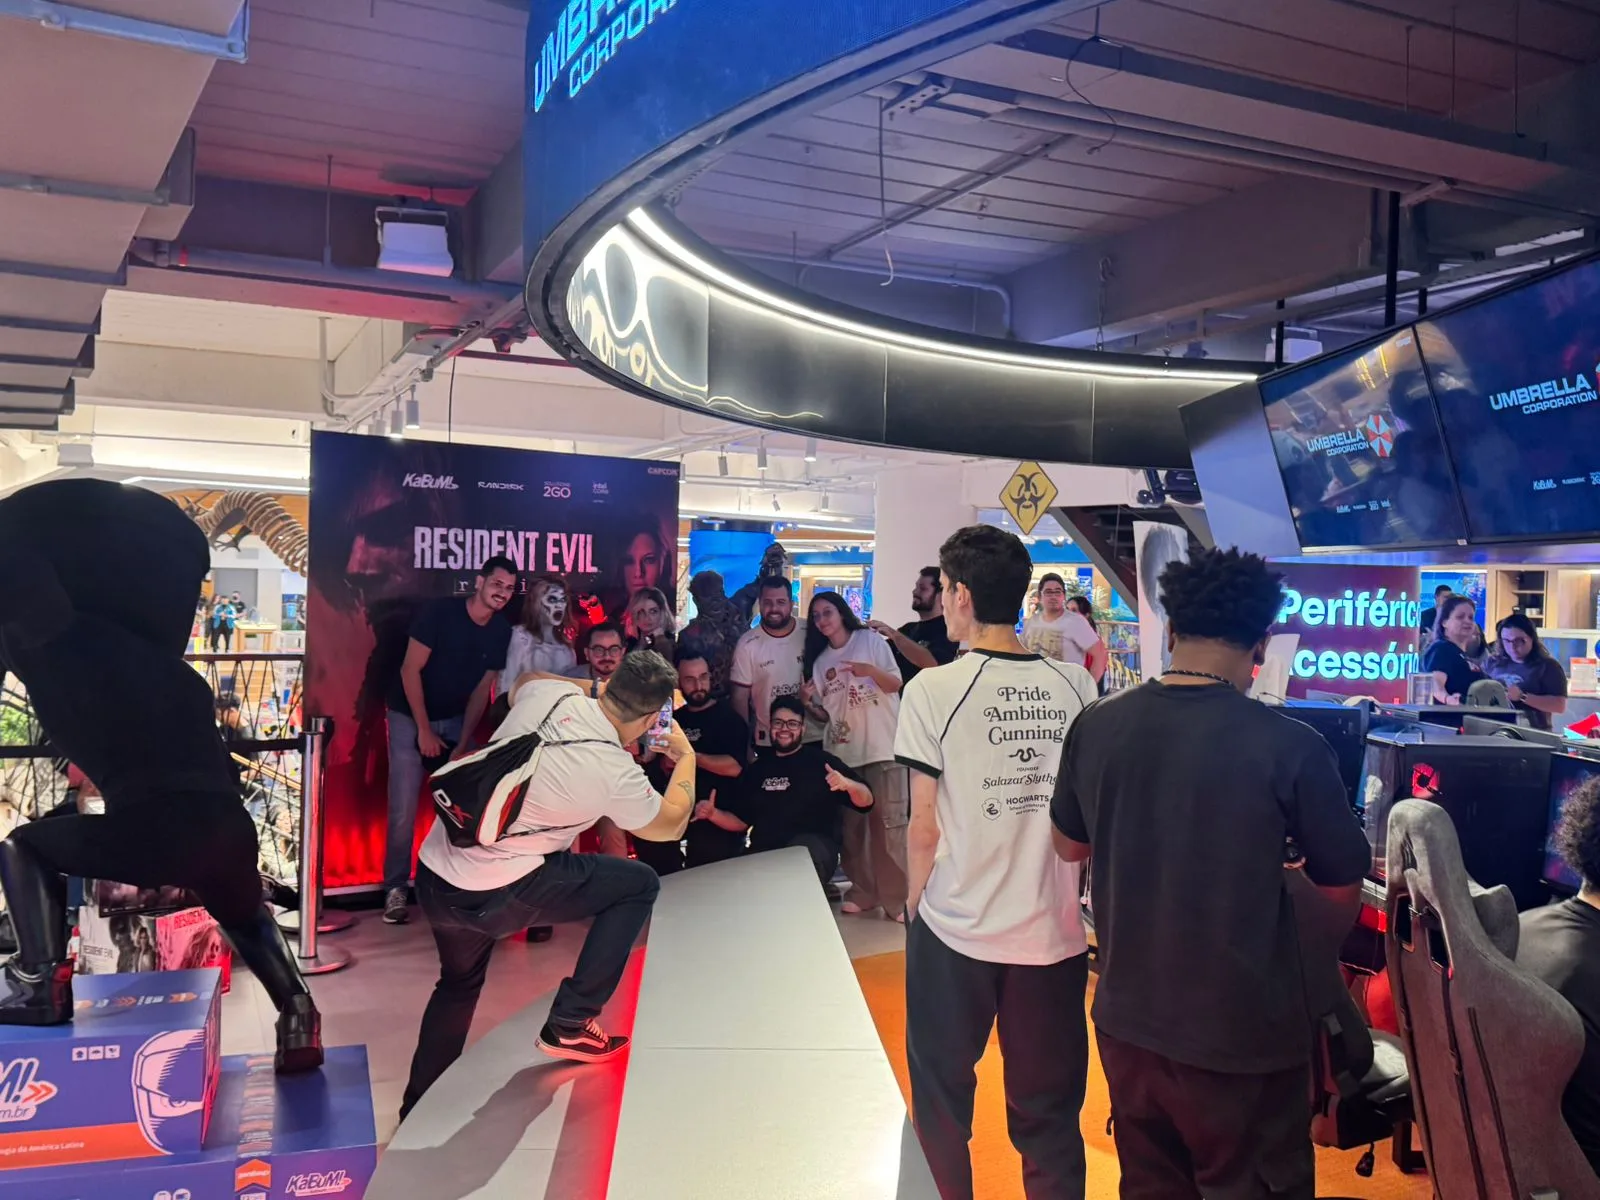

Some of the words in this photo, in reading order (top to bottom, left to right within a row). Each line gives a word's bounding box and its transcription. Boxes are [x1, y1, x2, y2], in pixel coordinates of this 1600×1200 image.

[1489, 373, 1591, 410] UMBRELLA
[1522, 390, 1598, 415] CORPORATION
[1306, 427, 1365, 452] UMBRELLA
[1326, 440, 1370, 456] CORPORATION
[543, 486, 571, 498] 2GO
[414, 526, 540, 571] RESIDENT
[546, 532, 599, 573] EVIL
[1289, 641, 1419, 680] cessório
[997, 686, 1051, 701] Pride
[983, 705, 1067, 725] Ambition
[988, 725, 1064, 745] Cunning
[982, 775, 1026, 789] Salazar
[1006, 794, 1049, 805] HOGWARTS
[285, 1170, 346, 1193] KaBuM!
